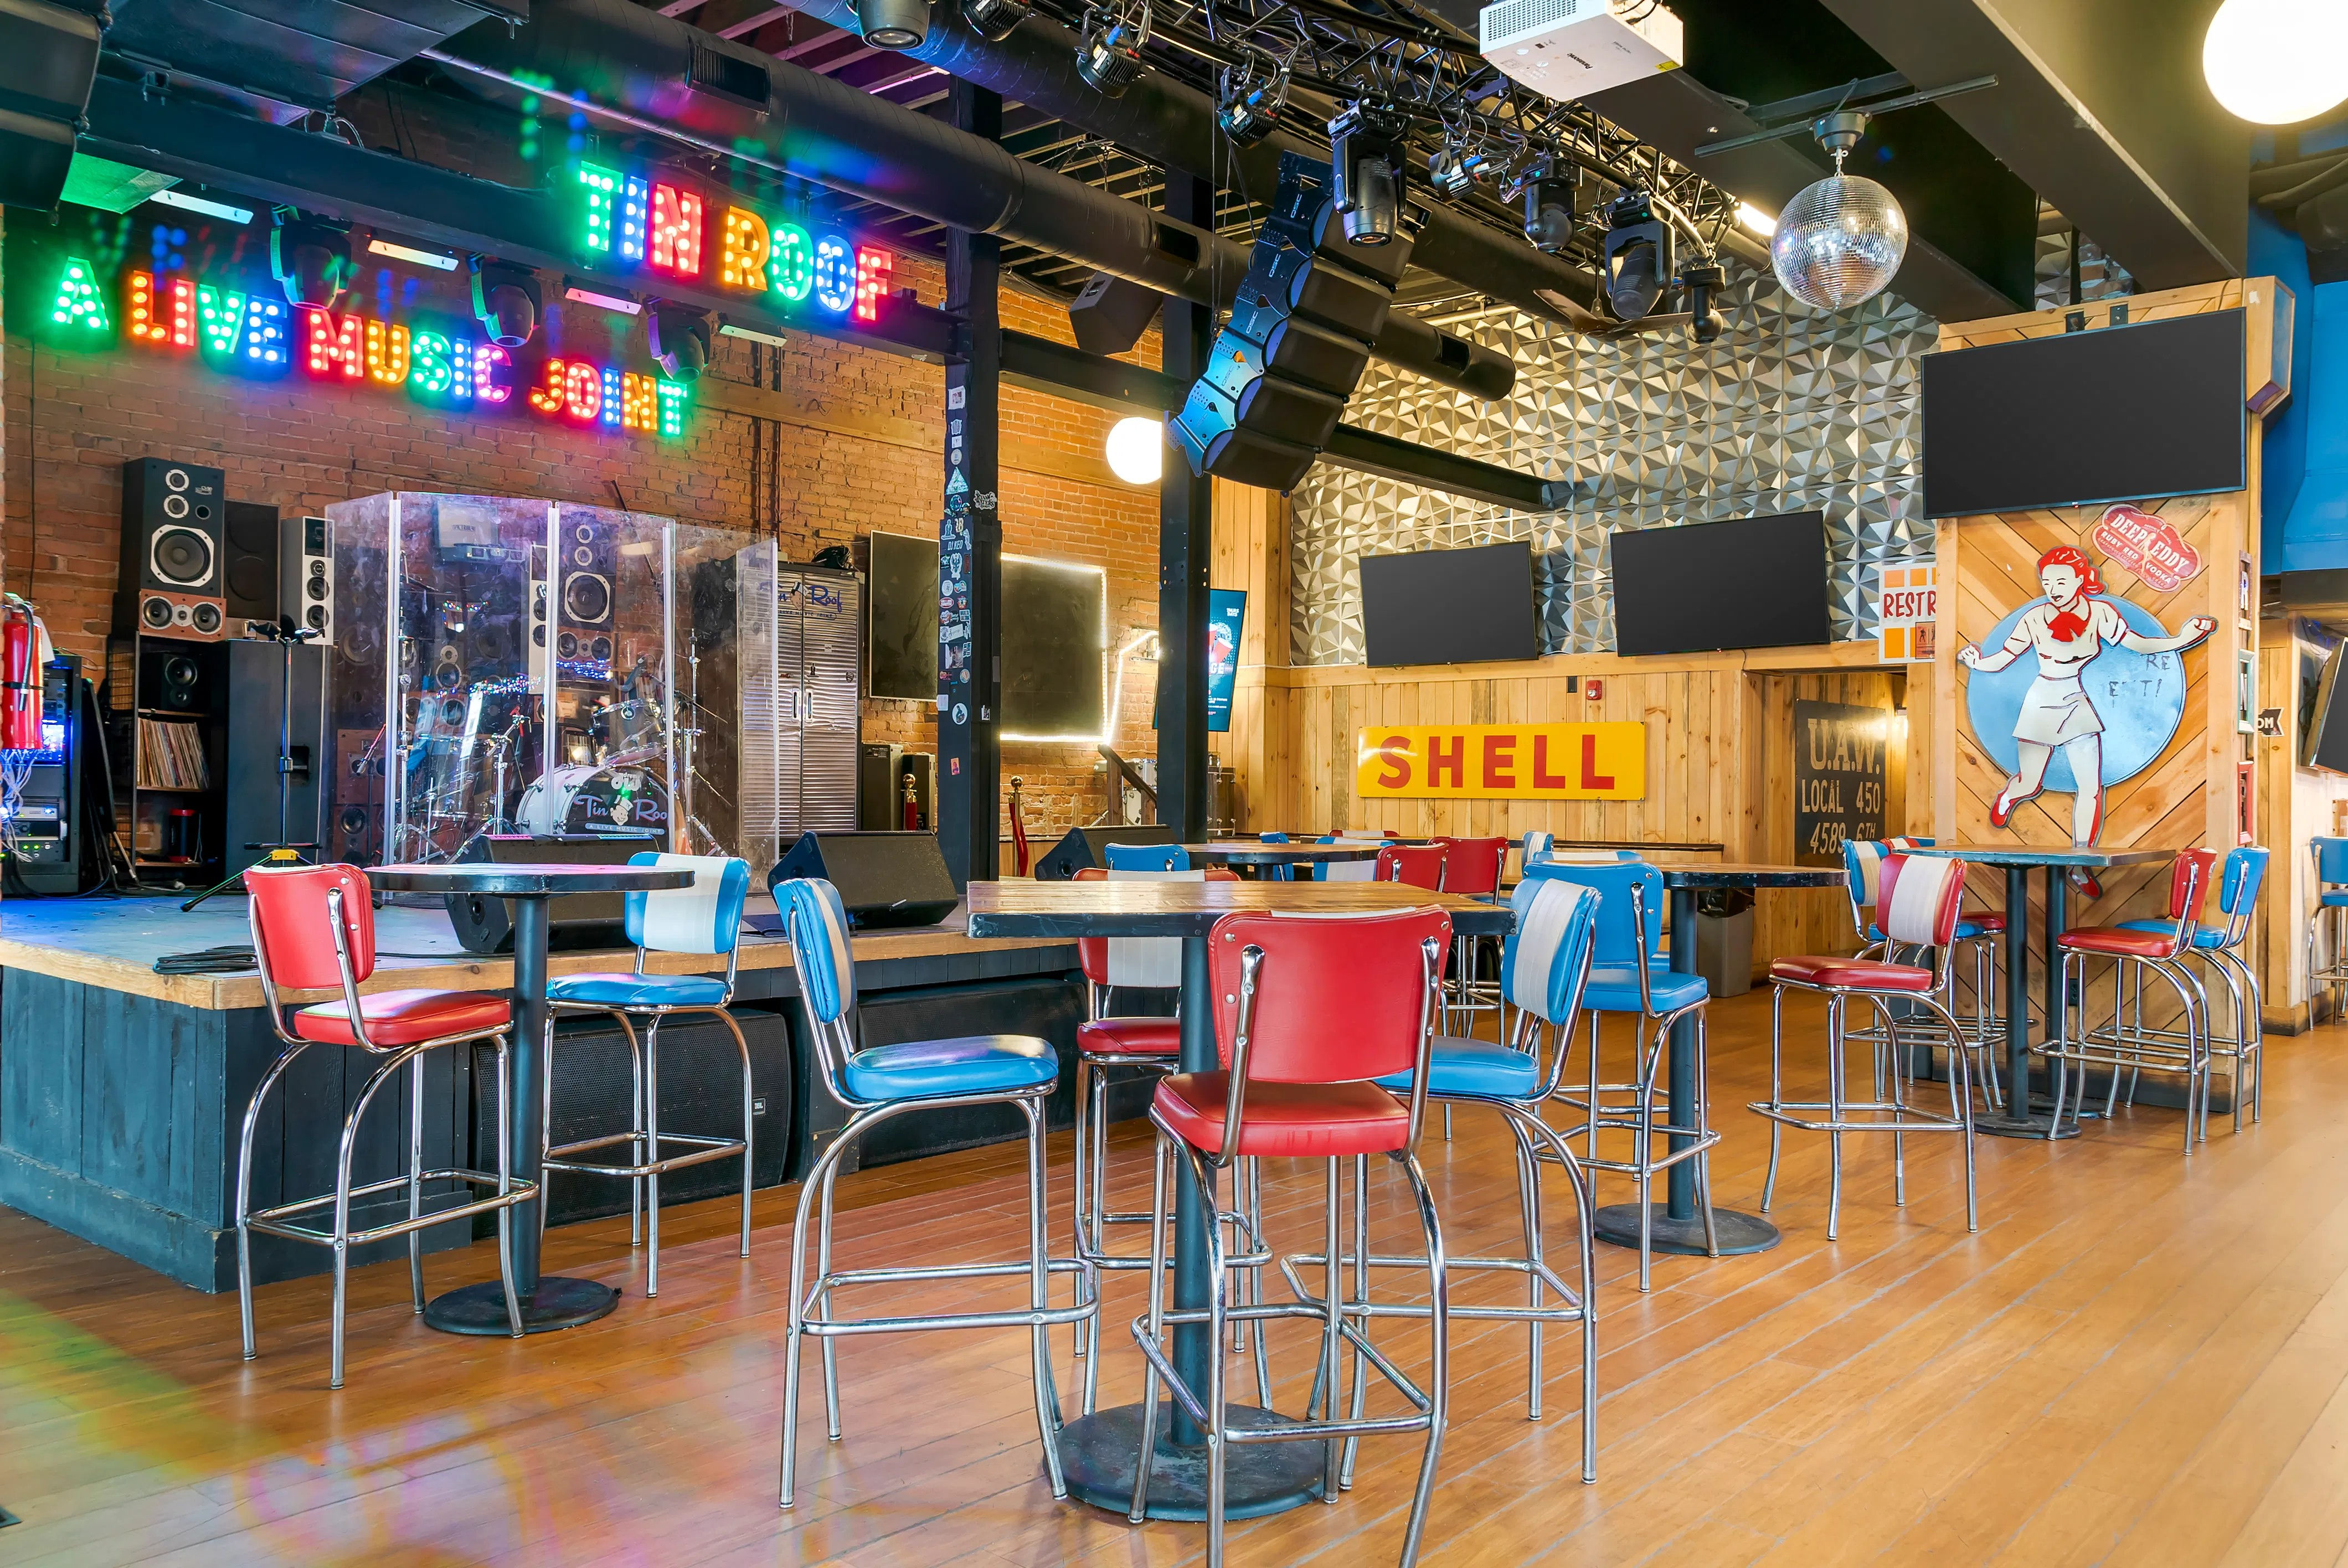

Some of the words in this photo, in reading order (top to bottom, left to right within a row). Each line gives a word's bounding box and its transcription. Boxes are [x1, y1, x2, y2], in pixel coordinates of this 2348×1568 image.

[579, 161, 702, 275] TIN
[723, 205, 892, 320] ROOF
[53, 256, 109, 331] A
[132, 270, 287, 363] LIVE
[309, 308, 512, 403] MUSIC
[529, 357, 688, 436] JOINT
[2100, 531, 2123, 548] RUBY
[2123, 546, 2139, 560] RED
[2110, 513, 2149, 543] DEEP
[2149, 540, 2190, 572] EDDY
[2145, 562, 2172, 584] VODKA
[809, 585, 842, 613] Roof
[1884, 590, 1936, 618] RESTR
[1377, 734, 1615, 790] SHELL
[573, 795, 609, 818] Tin
[633, 799, 668, 822] Roo
[1801, 779, 1844, 813] LOCAL
[1856, 781, 1881, 814] 450
[1810, 822, 1846, 855] 4589
